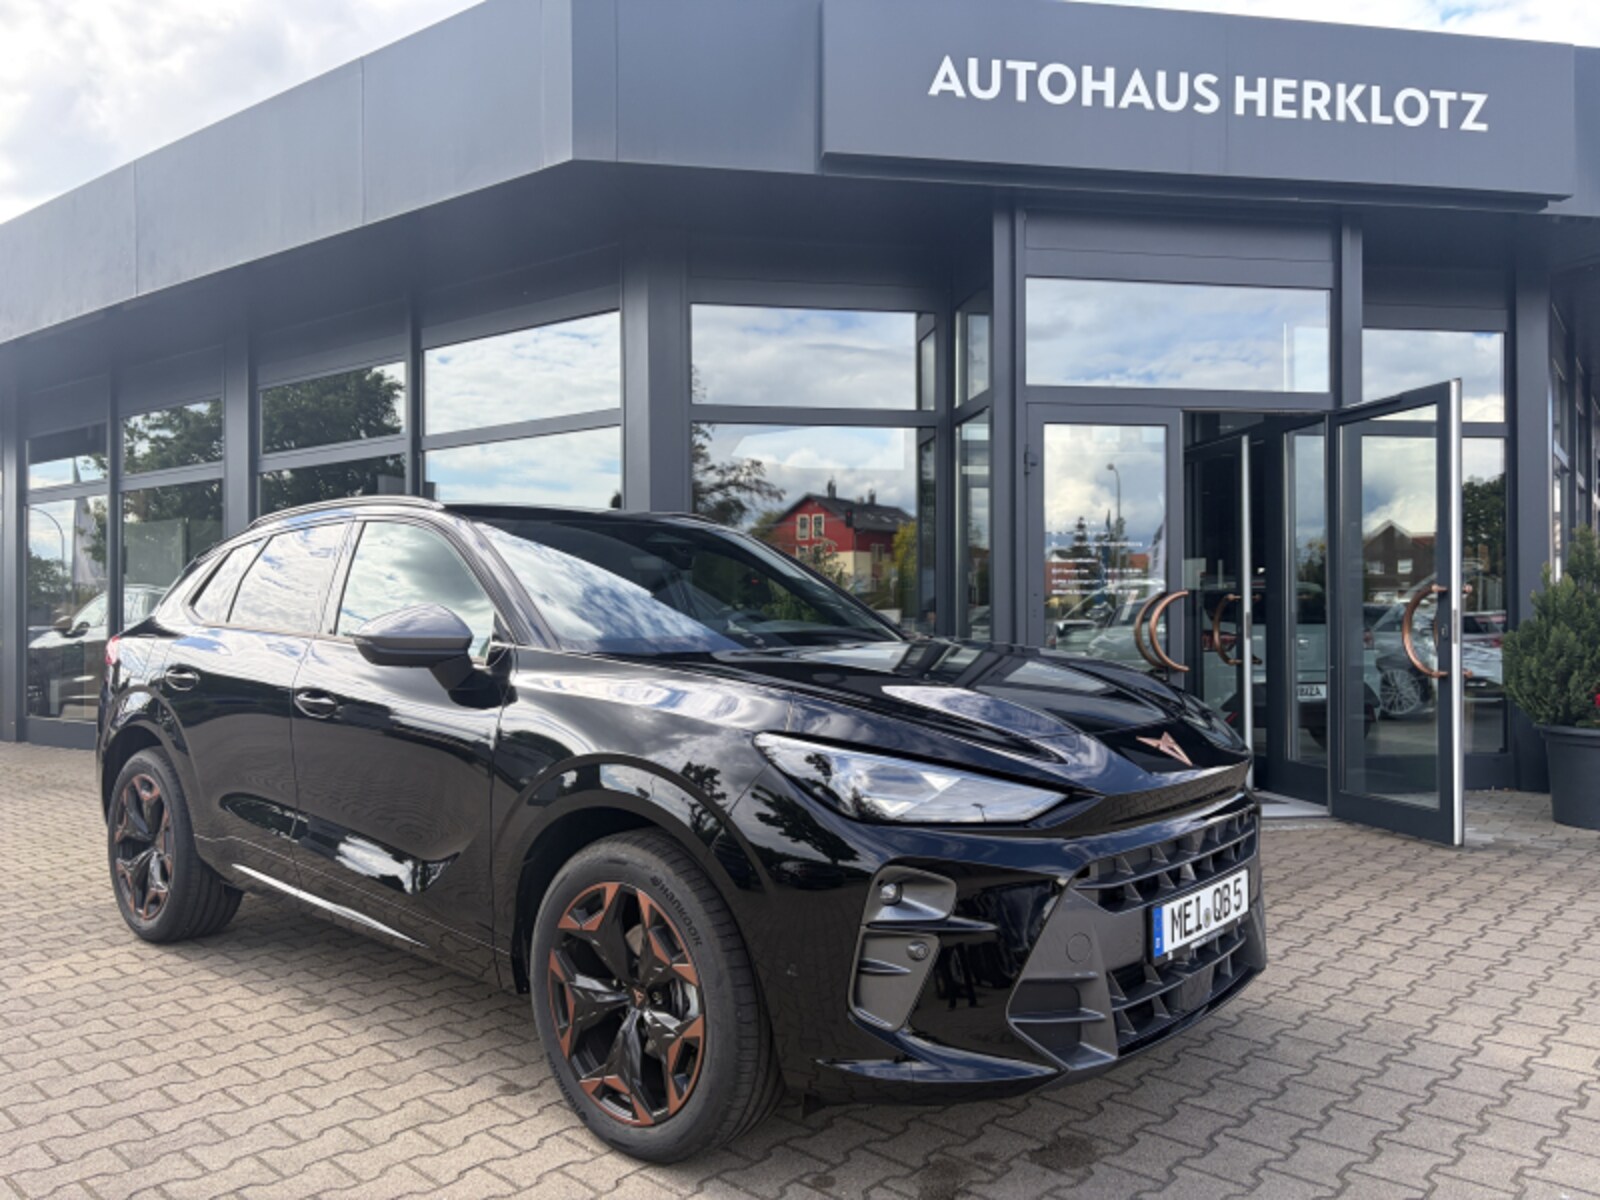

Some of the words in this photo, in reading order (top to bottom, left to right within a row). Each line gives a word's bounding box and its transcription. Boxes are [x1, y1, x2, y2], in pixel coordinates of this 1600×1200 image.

[928, 56, 1220, 114] AUTOHAUS
[1235, 76, 1488, 131] HERKLOTZ
[1171, 896, 1202, 943] MEI
